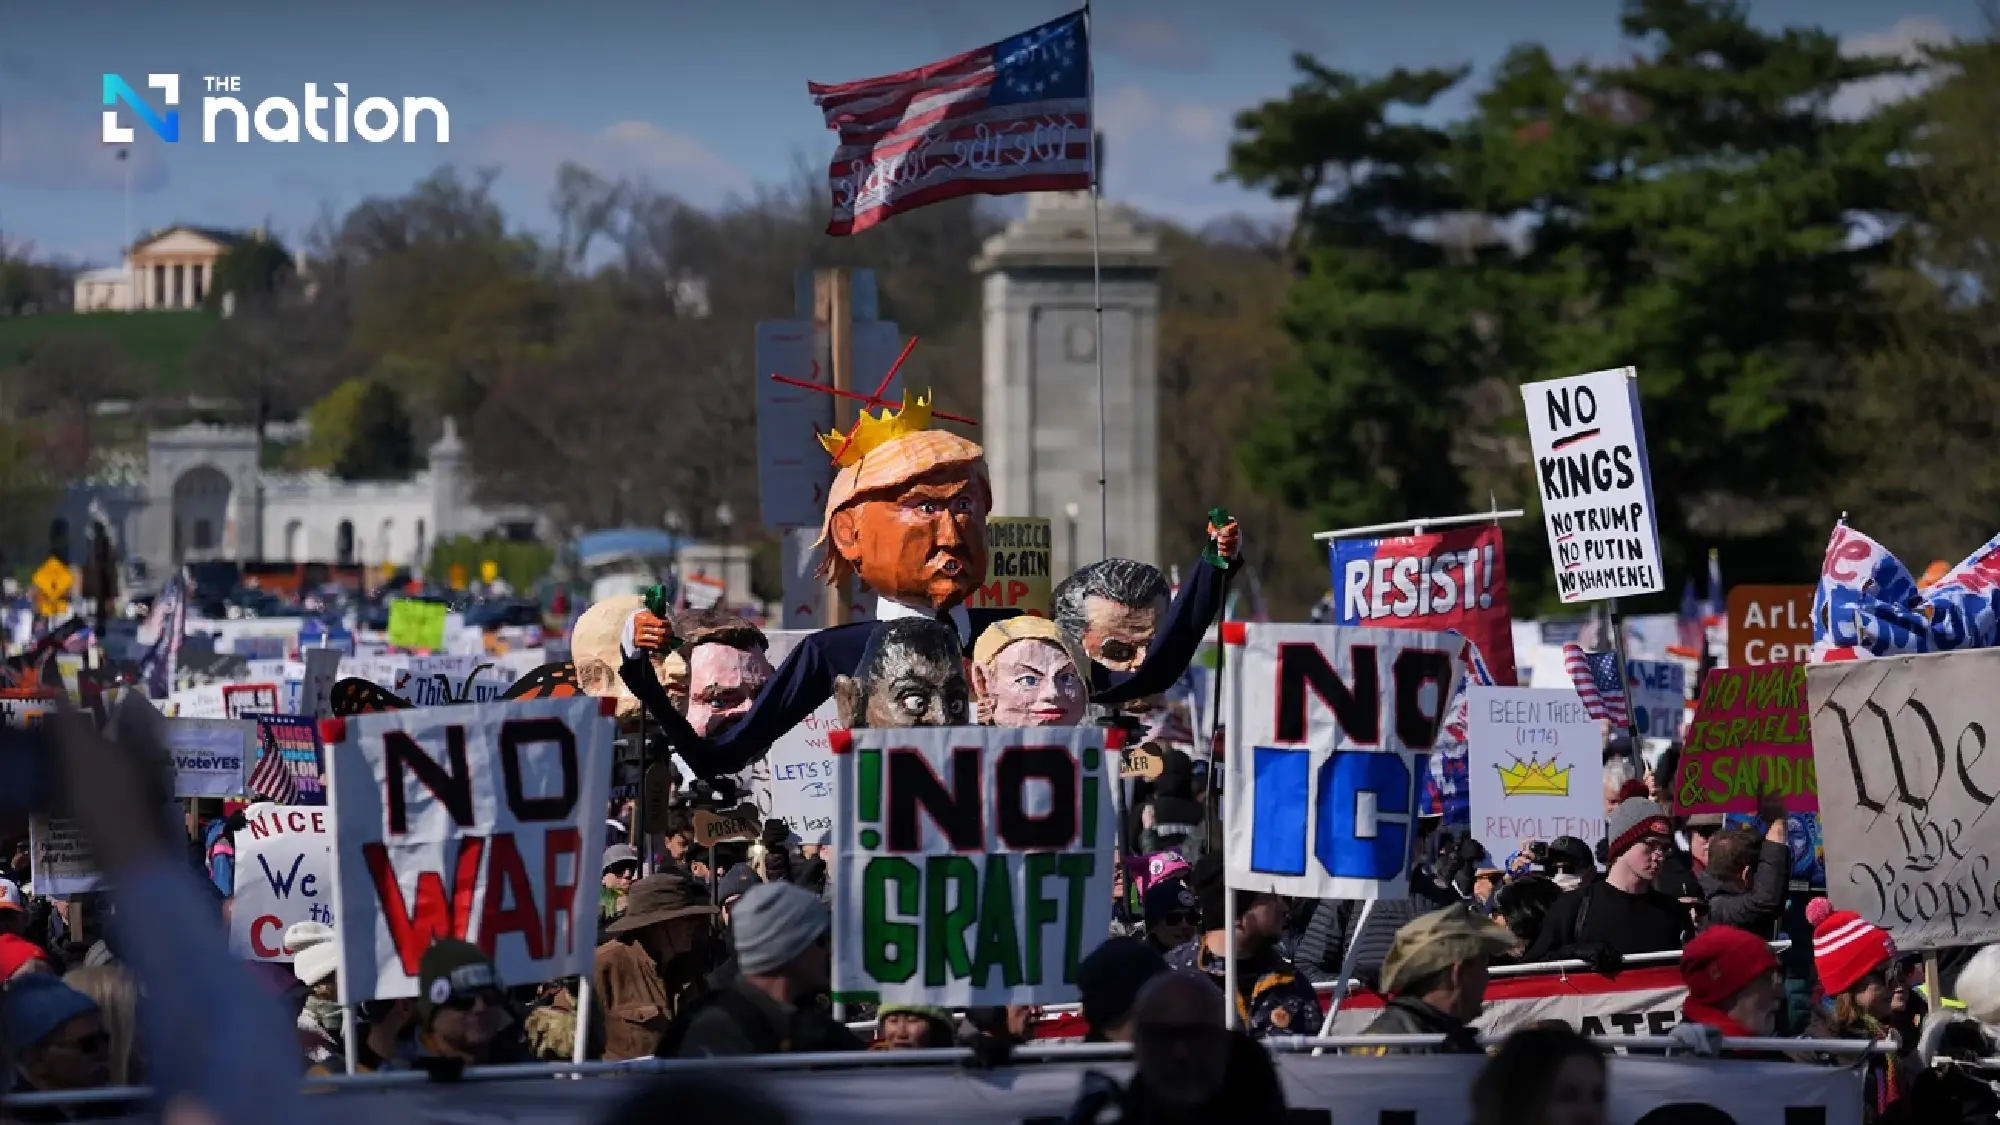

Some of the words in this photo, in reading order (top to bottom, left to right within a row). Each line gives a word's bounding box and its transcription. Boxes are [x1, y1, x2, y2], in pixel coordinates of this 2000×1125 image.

[1546, 385, 1597, 431] NO
[1540, 445, 1634, 500] KINGS
[1551, 512, 1573, 537] NO
[1574, 502, 1642, 533] TRUMP
[994, 551, 1049, 577] AGAIN
[1558, 541, 1579, 567] NO
[1585, 537, 1643, 561] PUTIN
[1345, 544, 1494, 621] RESIST!
[1558, 570, 1576, 593] NO
[1579, 564, 1655, 592] KHAMENEI
[1743, 600, 1809, 629] Arl.
[1274, 641, 1452, 750] NO
[1490, 700, 1541, 723] BEEN
[1546, 701, 1592, 724] THERE
[1704, 674, 1742, 715] NO
[1516, 726, 1559, 746] (1776)
[1805, 668, 1999, 834] We
[384, 715, 579, 835] NO
[775, 762, 818, 781] LET'S
[251, 812, 326, 840] NICE
[1250, 746, 1430, 881] IC
[1893, 800, 1977, 872] the
[257, 853, 318, 900] We
[363, 828, 582, 977] WAR
[863, 853, 1095, 988] GRAFT
